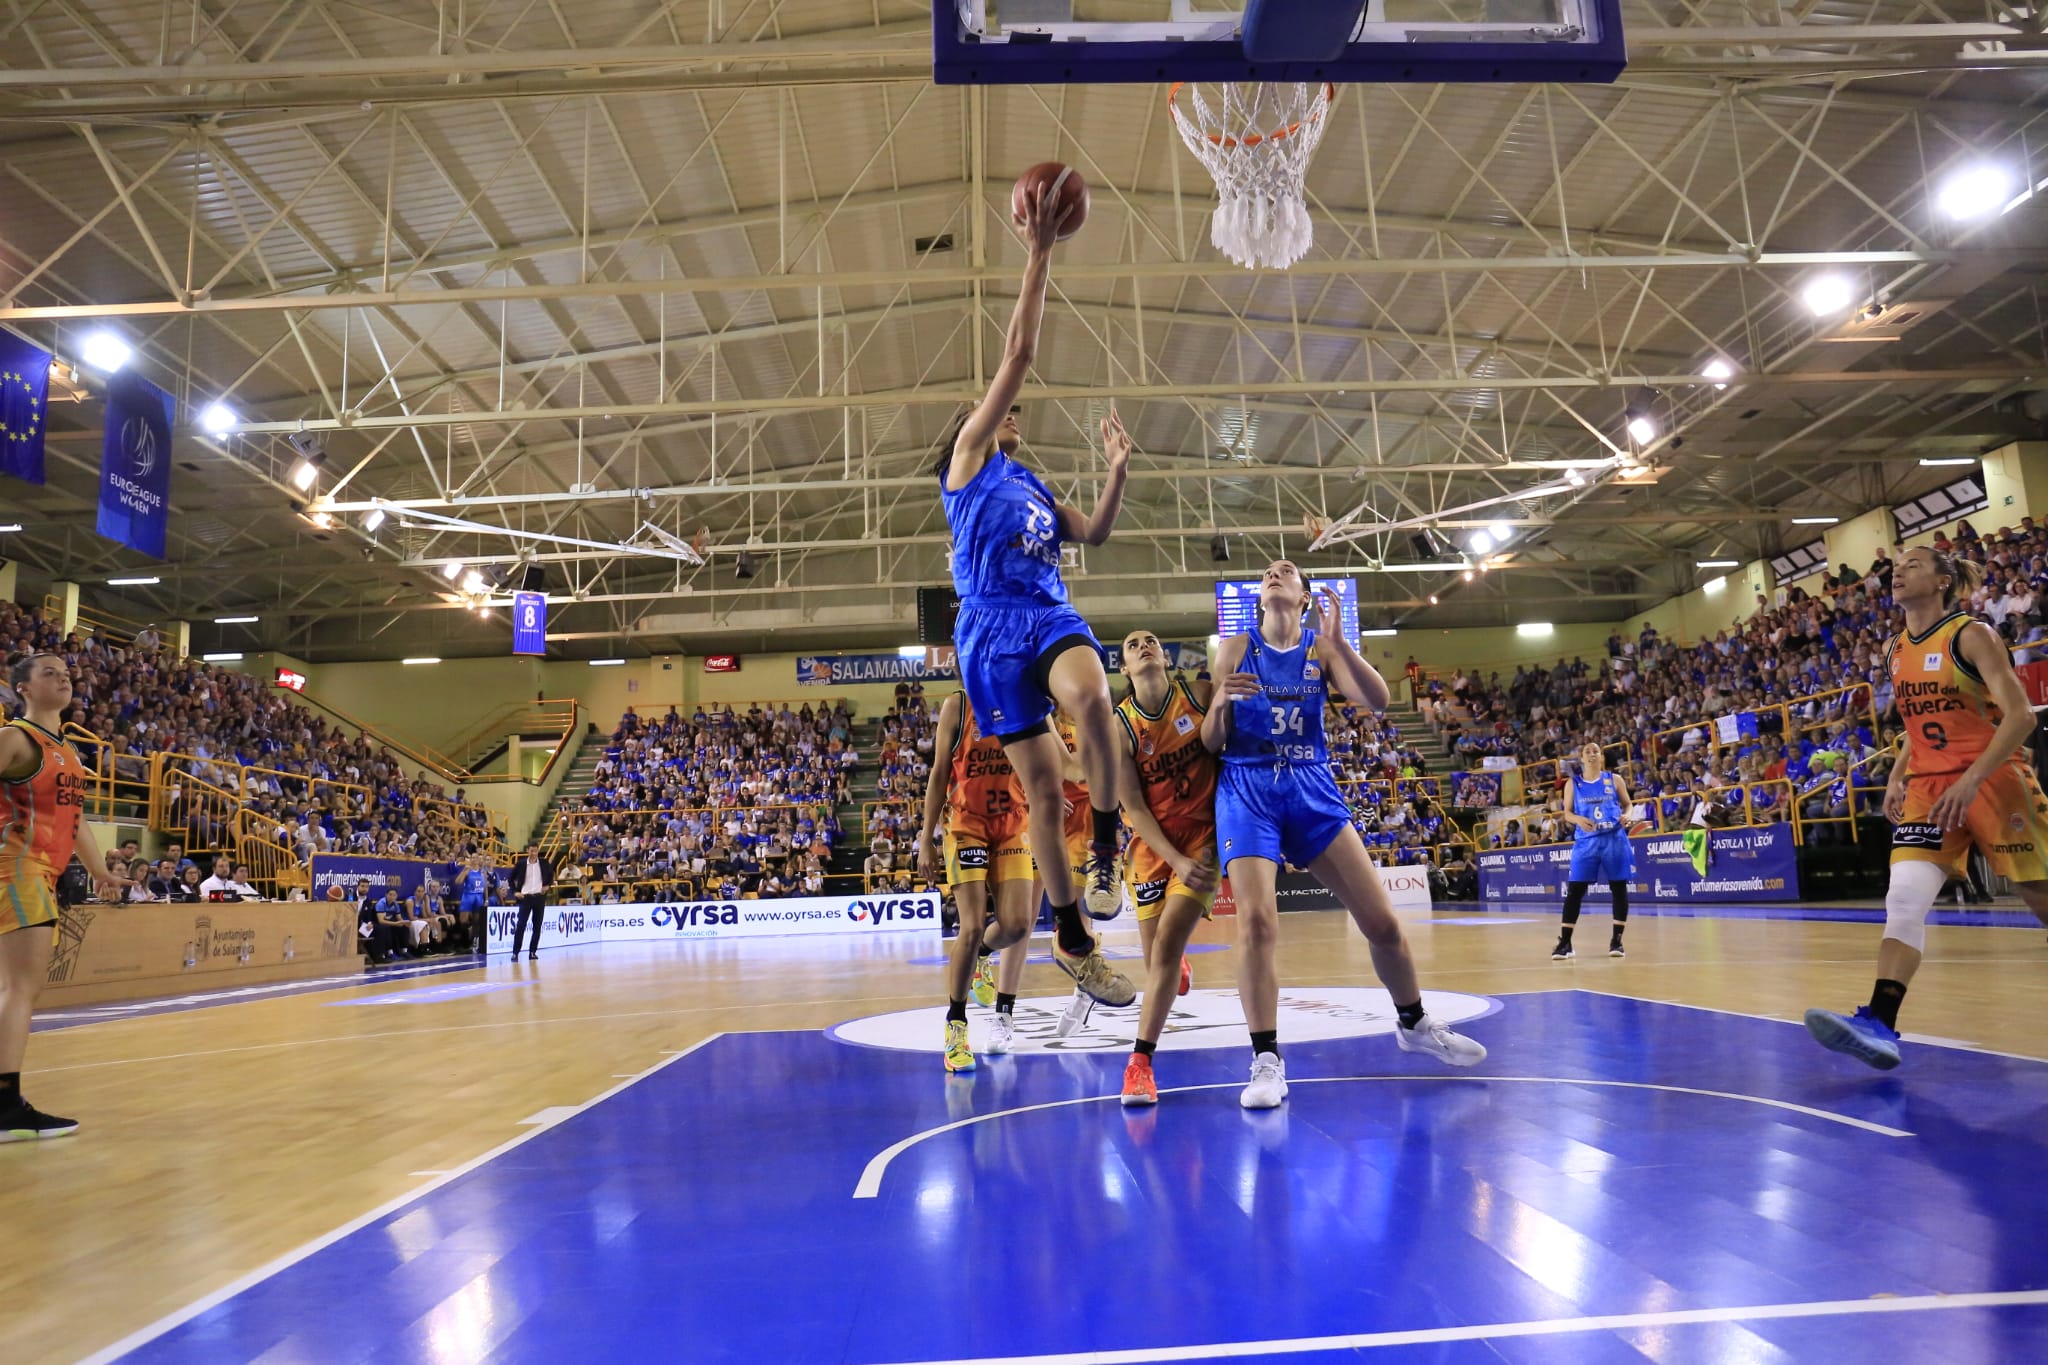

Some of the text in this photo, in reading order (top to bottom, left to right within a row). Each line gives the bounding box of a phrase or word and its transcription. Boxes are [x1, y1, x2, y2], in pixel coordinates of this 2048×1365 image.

[110, 473, 161, 507] EUROEAGUE
[524, 605, 536, 628] 8
[1271, 706, 1304, 736] 34
[1921, 721, 1948, 751] 9
[1273, 742, 1315, 760] yrsa
[1593, 806, 1603, 820] 6
[1291, 888, 1330, 896] FACTOR
[1691, 876, 1784, 896] perfumeriasavenida.com
[651, 904, 738, 930] oyrsa
[744, 908, 841, 922] www.oyrsa.es
[848, 898, 934, 926] oyrsa
[222, 943, 255, 957] Salamca
